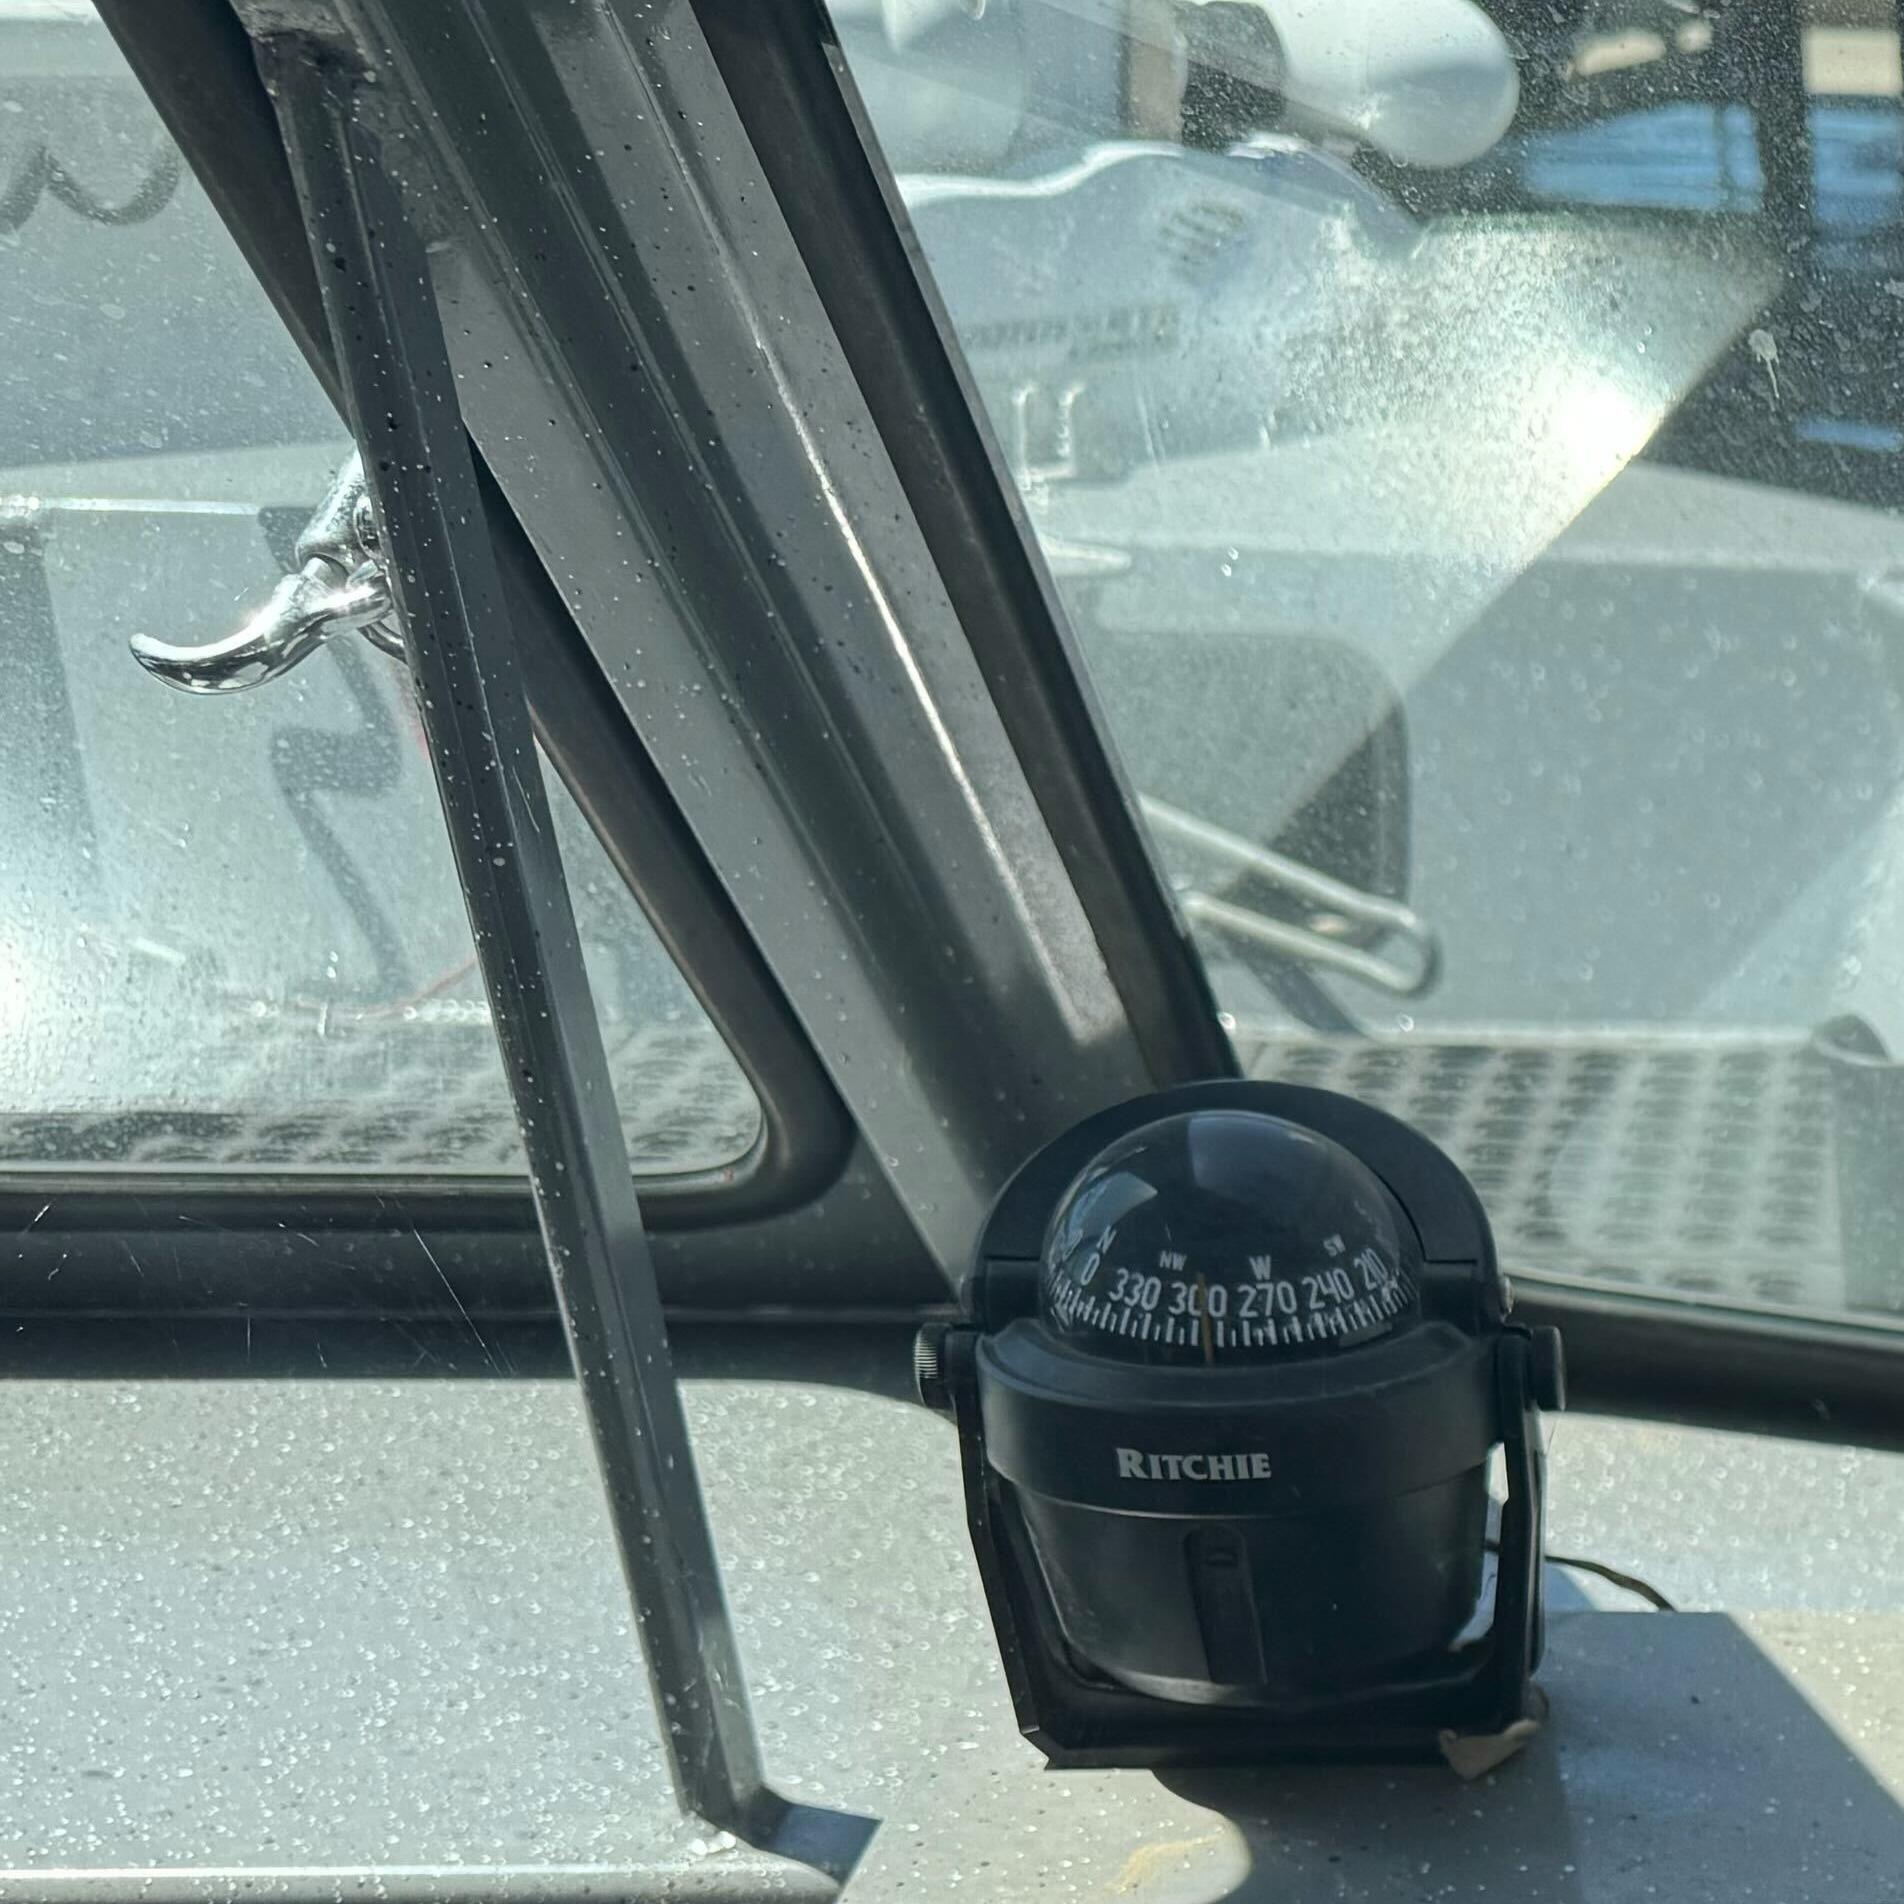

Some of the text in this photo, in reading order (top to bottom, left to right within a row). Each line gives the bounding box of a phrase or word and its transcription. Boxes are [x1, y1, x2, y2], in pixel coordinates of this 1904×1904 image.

[1159, 1249, 1188, 1273] NW
[1249, 1254, 1272, 1281] W
[1109, 1266, 1161, 1312] 330
[1168, 1283, 1228, 1318] 300
[1237, 1280, 1298, 1319] 270
[1301, 1265, 1356, 1311] 240
[1115, 1446, 1272, 1481] RITCHIE
